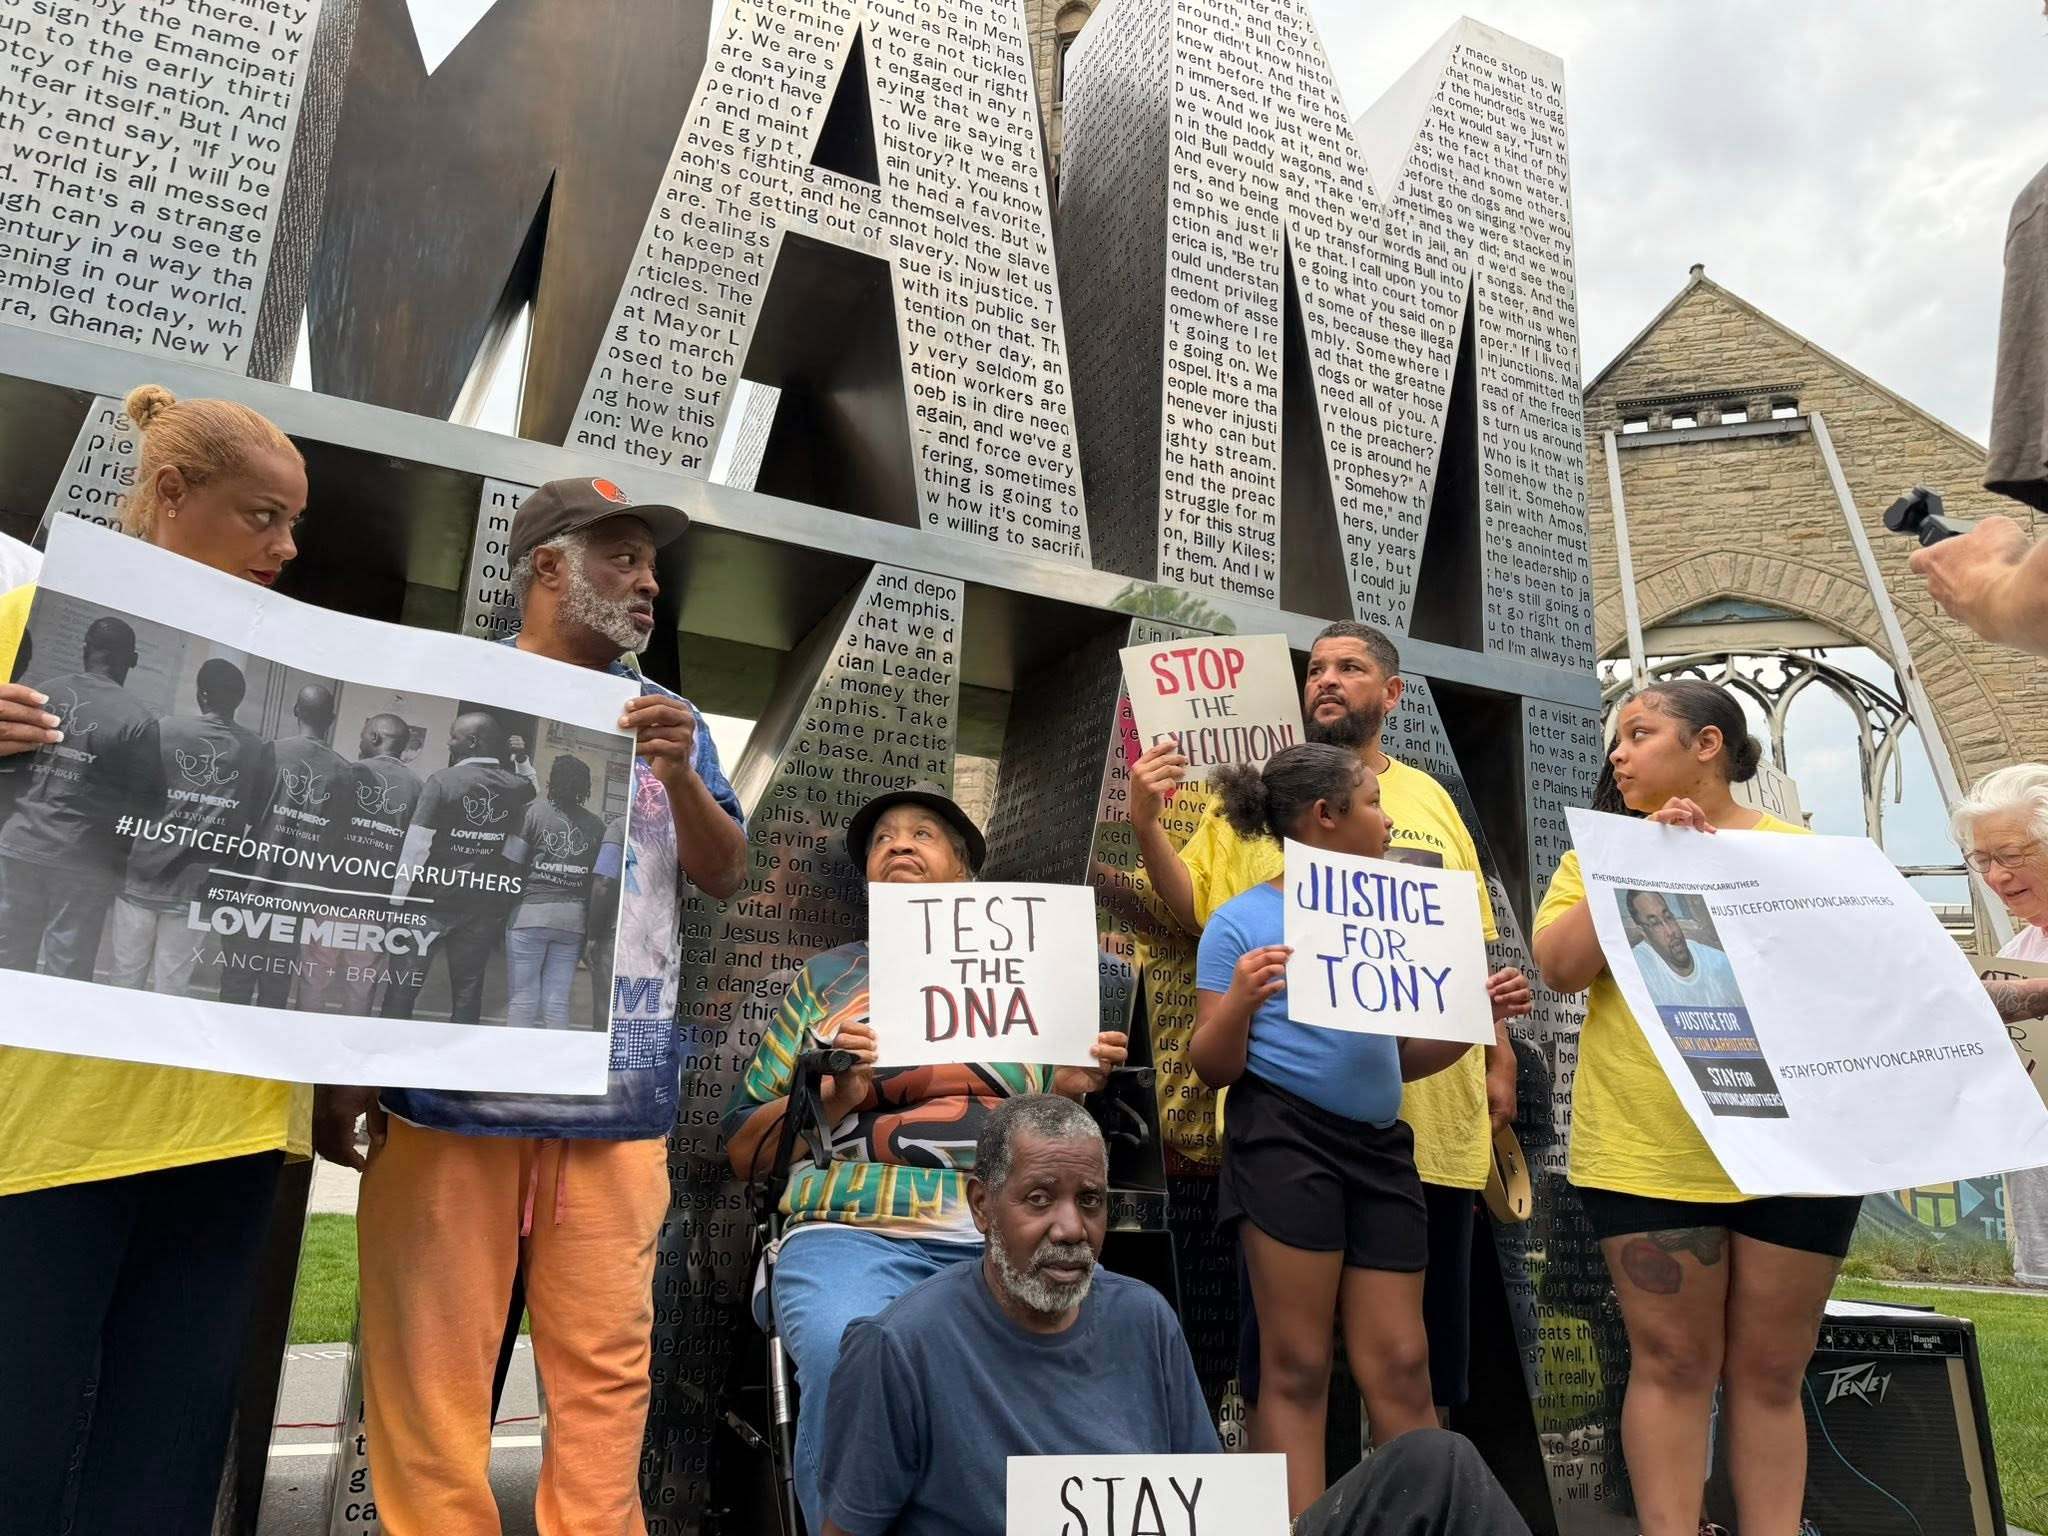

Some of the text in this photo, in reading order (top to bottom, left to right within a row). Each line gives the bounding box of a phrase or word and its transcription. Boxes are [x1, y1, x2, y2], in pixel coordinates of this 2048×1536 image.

[31, 0, 90, 29] sign
[101, 18, 145, 43] the
[45, 25, 75, 47] to
[87, 38, 134, 64] the
[145, 57, 215, 90] early
[720, 43, 827, 90] are saying
[10, 63, 78, 96] "fear
[178, 110, 223, 139] But
[230, 124, 239, 143] I
[64, 58, 287, 132] of his nation. And
[37, 125, 271, 198] century, I will be
[64, 108, 277, 177] and say, "If you
[32, 169, 262, 244] That's a strange
[742, 146, 1030, 251] fighting among themselves. But
[1174, 144, 1202, 165] And
[1205, 158, 1247, 183] every
[1251, 174, 1280, 192] now
[1284, 186, 1311, 204] and
[1314, 195, 1346, 217] then
[1349, 210, 1381, 230] we'd
[1384, 222, 1408, 240] get
[1411, 230, 1423, 245] in
[738, 168, 1050, 276] court, and he cannot hold the slave
[901, 277, 1024, 325] with its public
[49, 304, 144, 345] Ghana;
[151, 327, 211, 356] New
[637, 328, 735, 367] to march
[1355, 341, 1440, 378] Somewhere
[915, 404, 1057, 452] again, and we've
[1519, 408, 1582, 438] America is
[1366, 432, 1434, 460] preacher?
[1483, 445, 1585, 487] Who is it that is
[923, 466, 1079, 518] thing is going to
[1164, 488, 1258, 521] struggle for
[946, 491, 1082, 541] how it's coming
[1193, 529, 1275, 565] Billy Kiles;
[1346, 533, 1416, 561] any years
[1486, 548, 1578, 584] the leadership
[876, 573, 957, 601] and depo
[864, 633, 937, 662] have an
[1529, 646, 1576, 668] always
[840, 676, 905, 703] money
[882, 658, 952, 686] Leader
[1150, 648, 1245, 696] STOP
[1185, 695, 1238, 718] THE
[806, 716, 865, 738] some
[1528, 721, 1596, 747] letter said
[1530, 761, 1568, 777] never
[115, 815, 522, 894] #JUSTICEFORTONYVONCARRUTHERS
[1390, 827, 1446, 849] eaven
[208, 887, 427, 926] #STAYFORTONYVONCARRUTHERS
[1297, 862, 1444, 925] JUSTICE
[1710, 895, 1895, 917] #JUSTICEFORTONYVONCARRUTHERS
[187, 901, 440, 957] LOVE MERCY
[719, 922, 840, 949] Jesus knew
[907, 896, 1047, 955] TEST
[1342, 923, 1414, 962] FOR
[211, 951, 319, 977] ANCIENT
[346, 966, 425, 988] BRAVE
[724, 951, 763, 970] and
[950, 957, 1026, 985] THE
[1316, 954, 1451, 1014] TONY
[920, 985, 1039, 1042] DNA
[1778, 1042, 1985, 1079] #STAYFORTONYVONCARRUTHERS
[1912, 1334, 1942, 1344] Bandit
[1061, 1476, 1203, 1536] STAY
